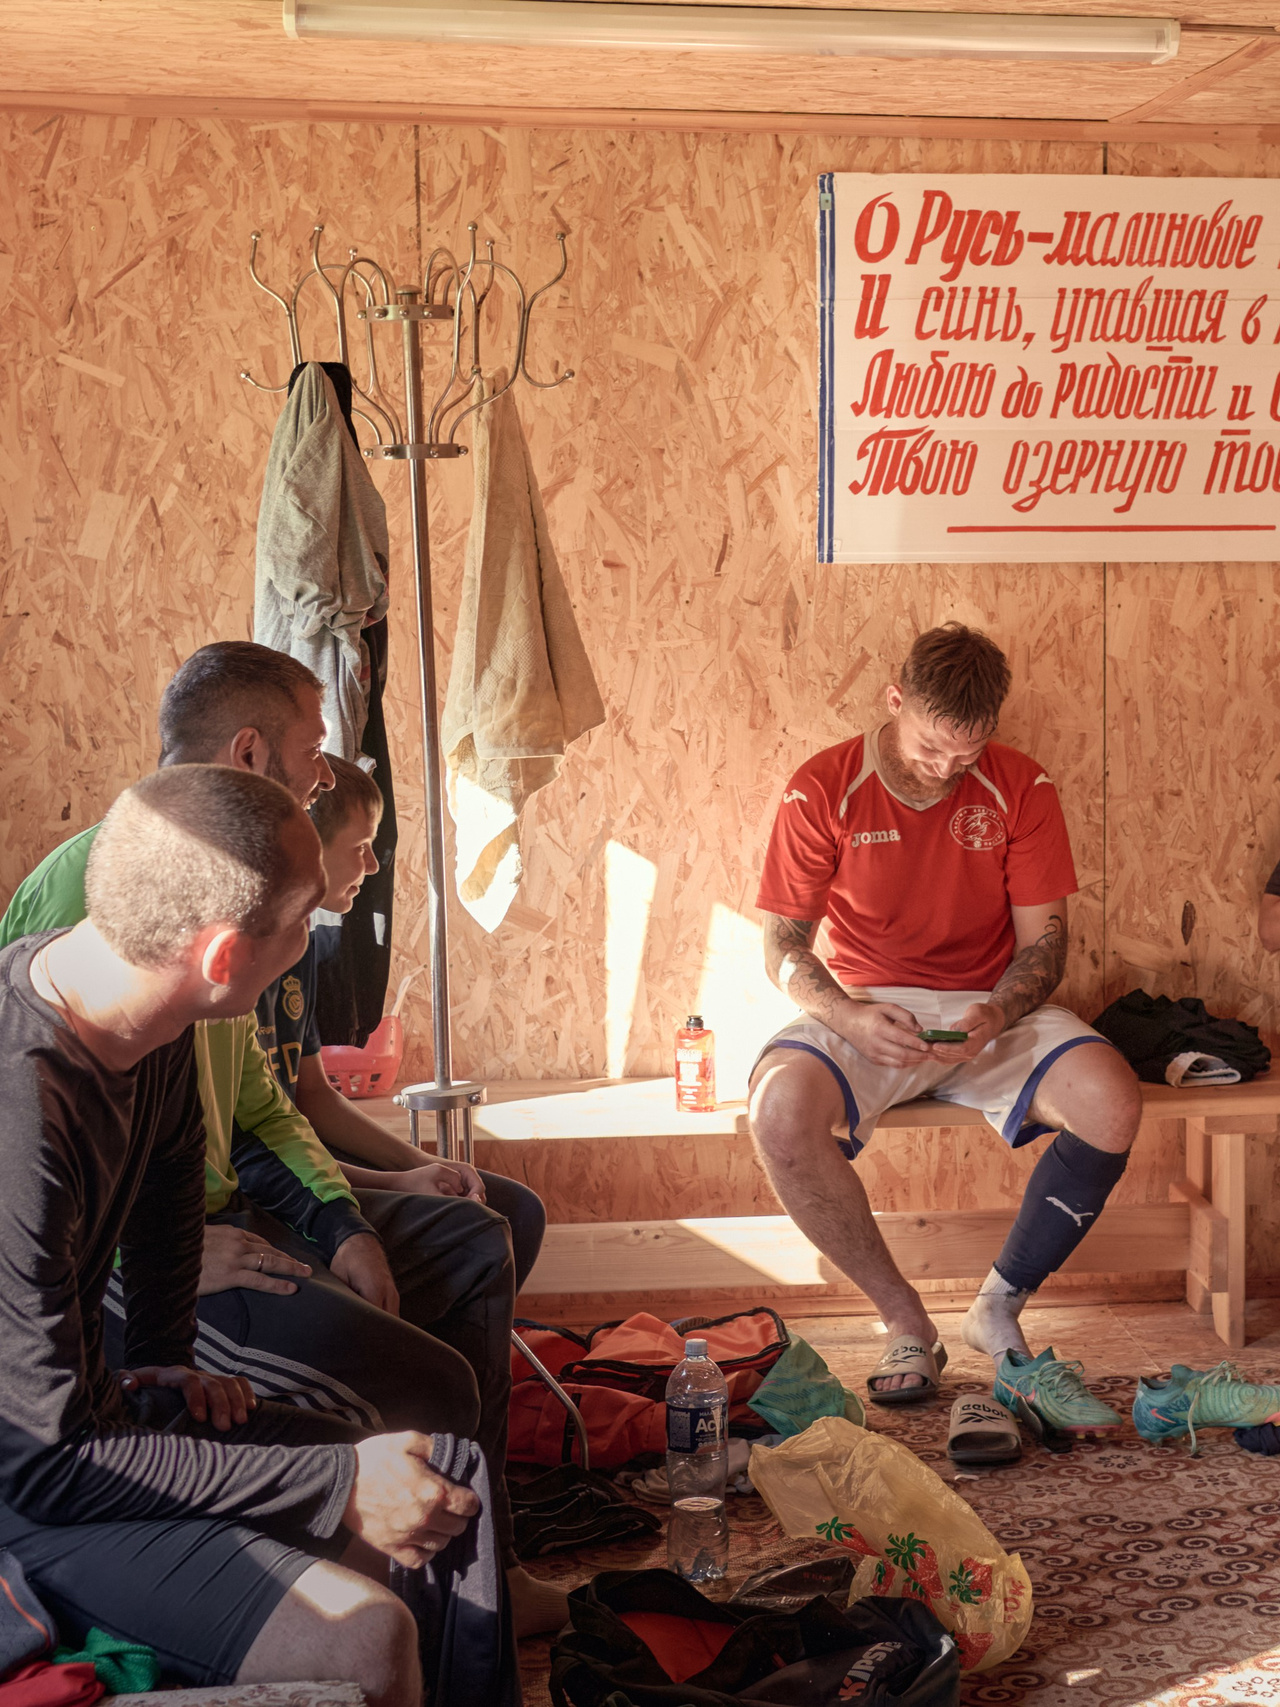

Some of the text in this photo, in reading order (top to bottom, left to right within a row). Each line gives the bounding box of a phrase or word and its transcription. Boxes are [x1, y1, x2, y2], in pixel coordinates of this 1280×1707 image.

[854, 192, 900, 263] О
[854, 274, 891, 339] И
[915, 286, 1035, 350] синь,
[1050, 276, 1229, 353] упавшая
[1241, 294, 1268, 345] в
[851, 349, 996, 419] Люблю
[1001, 366, 1043, 419] до
[1227, 385, 1255, 421] и
[849, 426, 978, 496] Твою
[1002, 440, 1187, 513] озерную
[952, 1403, 1009, 1420] eebok
